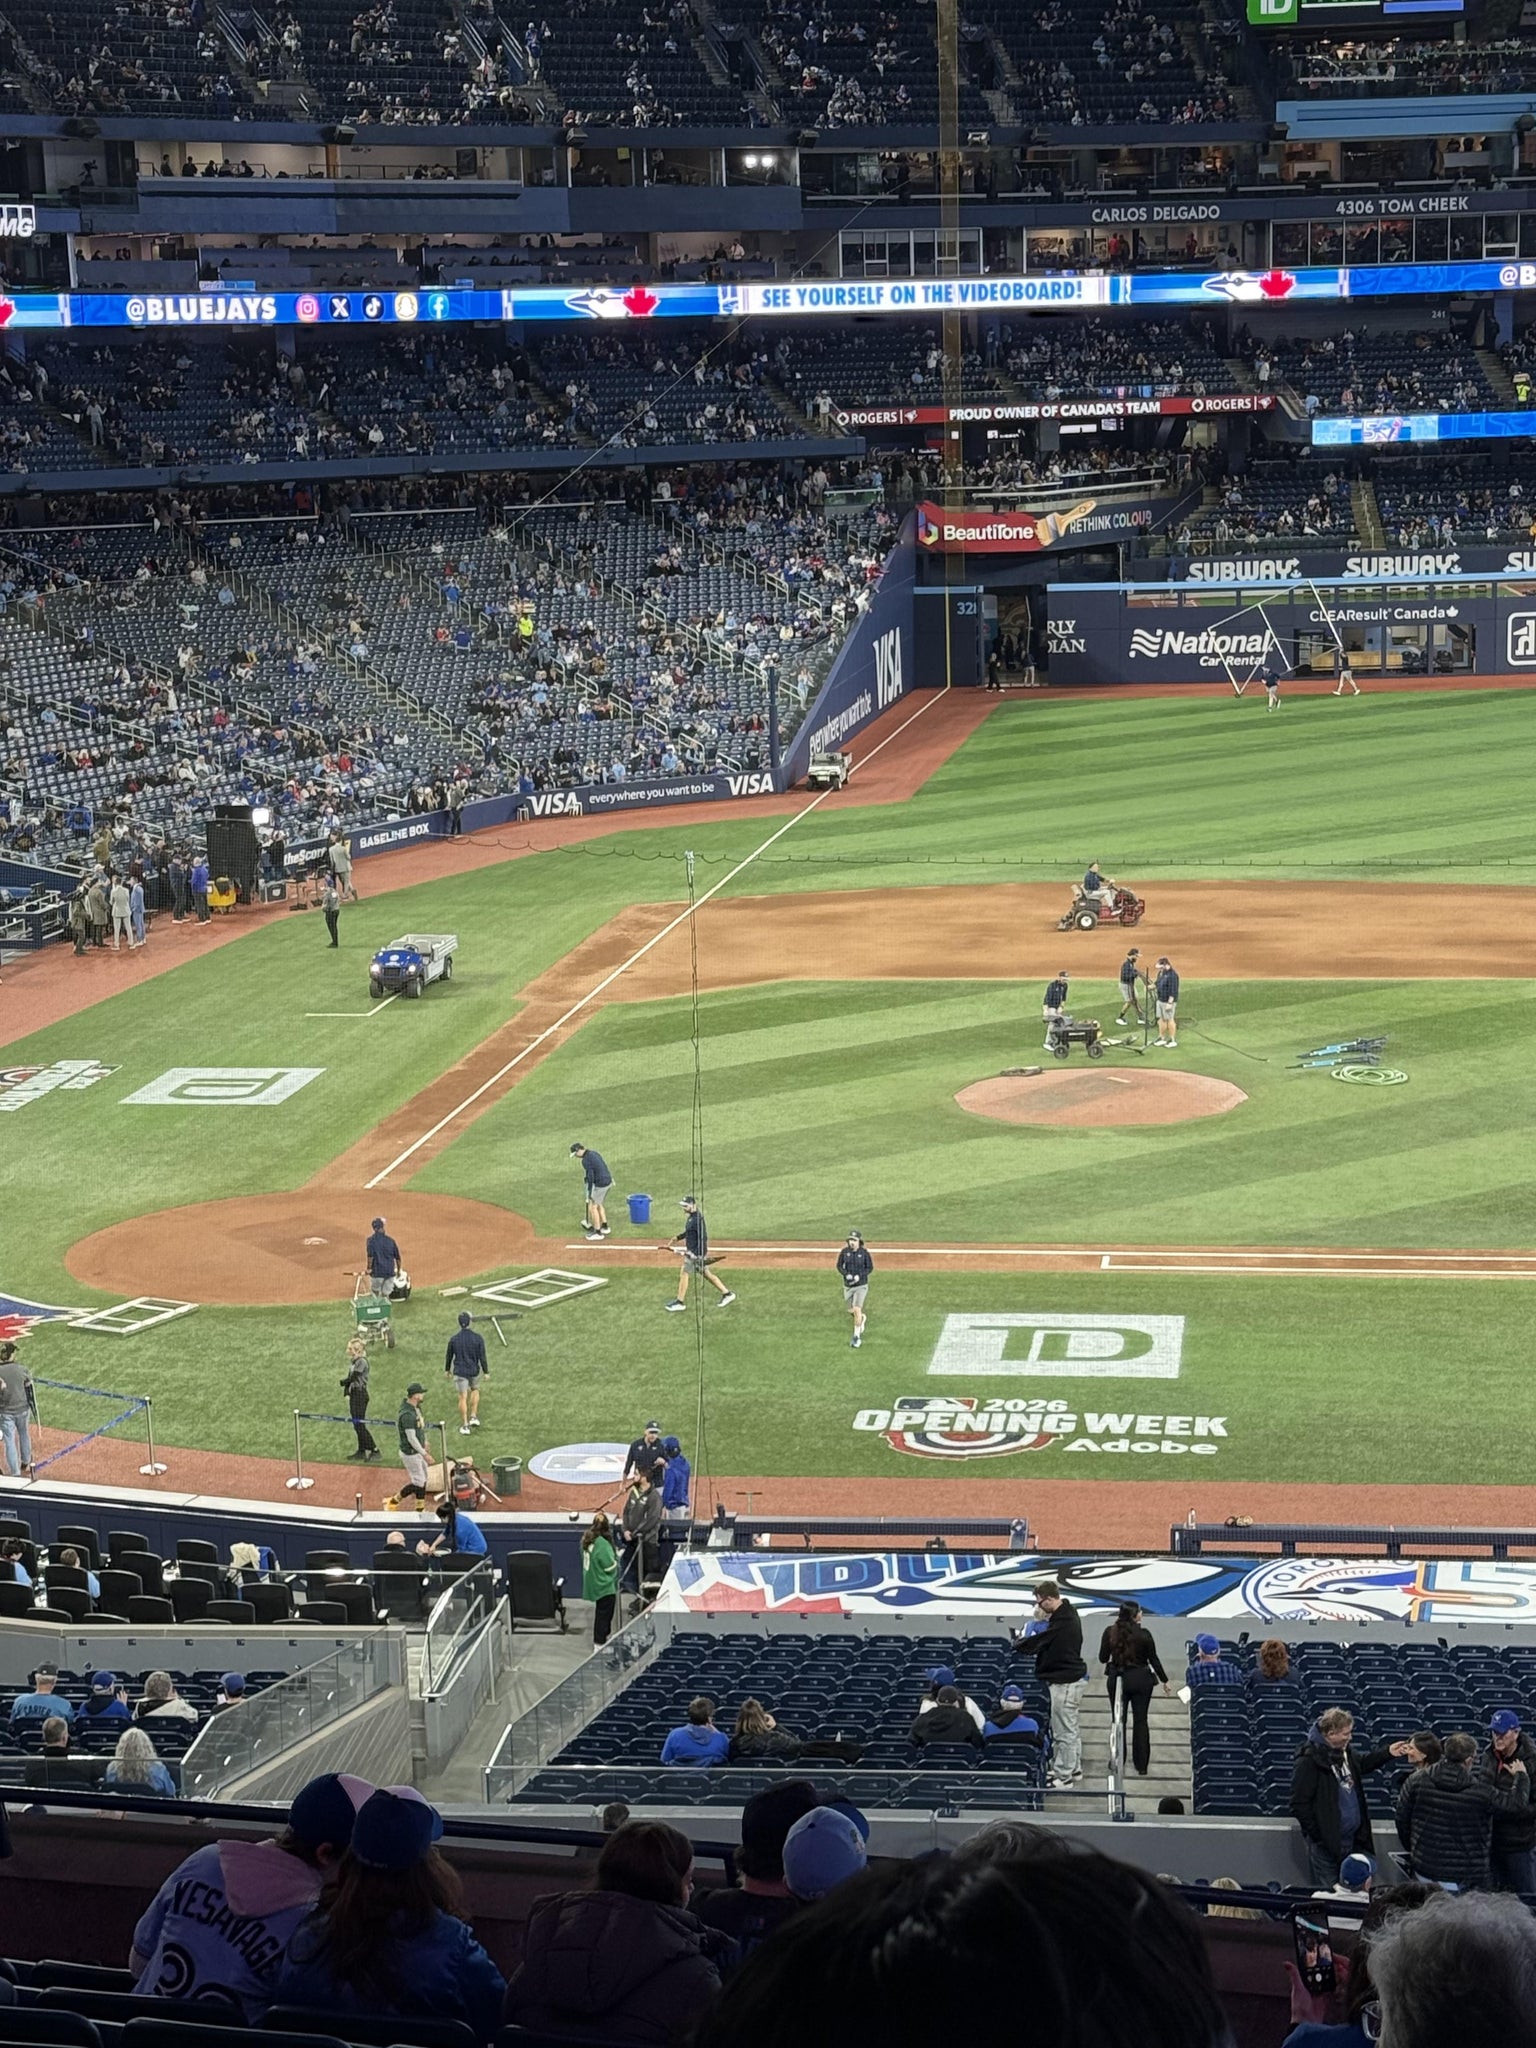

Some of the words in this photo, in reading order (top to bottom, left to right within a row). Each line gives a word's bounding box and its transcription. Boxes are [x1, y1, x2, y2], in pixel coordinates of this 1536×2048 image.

[1091, 206, 1147, 222] CARLOS
[1152, 205, 1220, 221] DELGADO
[1335, 199, 1375, 215] 4306
[1378, 198, 1414, 214] TOM
[1418, 196, 1468, 212] CHEEK
[762, 287, 791, 307] SEE
[799, 285, 883, 307] YOURSELF
[891, 285, 915, 304] ON
[922, 283, 953, 304] THE
[958, 281, 1082, 303] VIDEOBOARD!
[126, 297, 276, 321] @BLUEJAYS
[851, 411, 897, 424] ROGERS
[949, 407, 992, 420] PROUD
[994, 406, 1039, 420] OWNER
[1041, 405, 1059, 417] OF
[1060, 402, 1124, 417] CANADA'S
[1125, 401, 1160, 415] TEAM
[1205, 398, 1251, 411] ROGERS
[1070, 515, 1112, 535] RETHINK
[1185, 557, 1302, 582] SUBWAY
[1342, 552, 1462, 579] SUBWAY
[1394, 605, 1445, 620] Canada
[1162, 629, 1272, 654] National
[873, 626, 903, 710] VISA
[1200, 655, 1220, 667] Car
[1226, 655, 1267, 666] Rental
[589, 789, 646, 804] everywhere
[646, 788, 665, 800] you
[666, 786, 690, 797] want
[691, 785, 701, 794] to
[702, 782, 714, 793] be
[725, 773, 774, 796] VISA
[527, 791, 578, 816] VISA
[360, 827, 408, 849] BASELINE
[409, 822, 430, 838] BOX
[983, 1399, 1068, 1413] 2026
[852, 1410, 1077, 1434] OPENING
[1083, 1412, 1228, 1437] WEEK
[1063, 1438, 1218, 1454] Adobe
